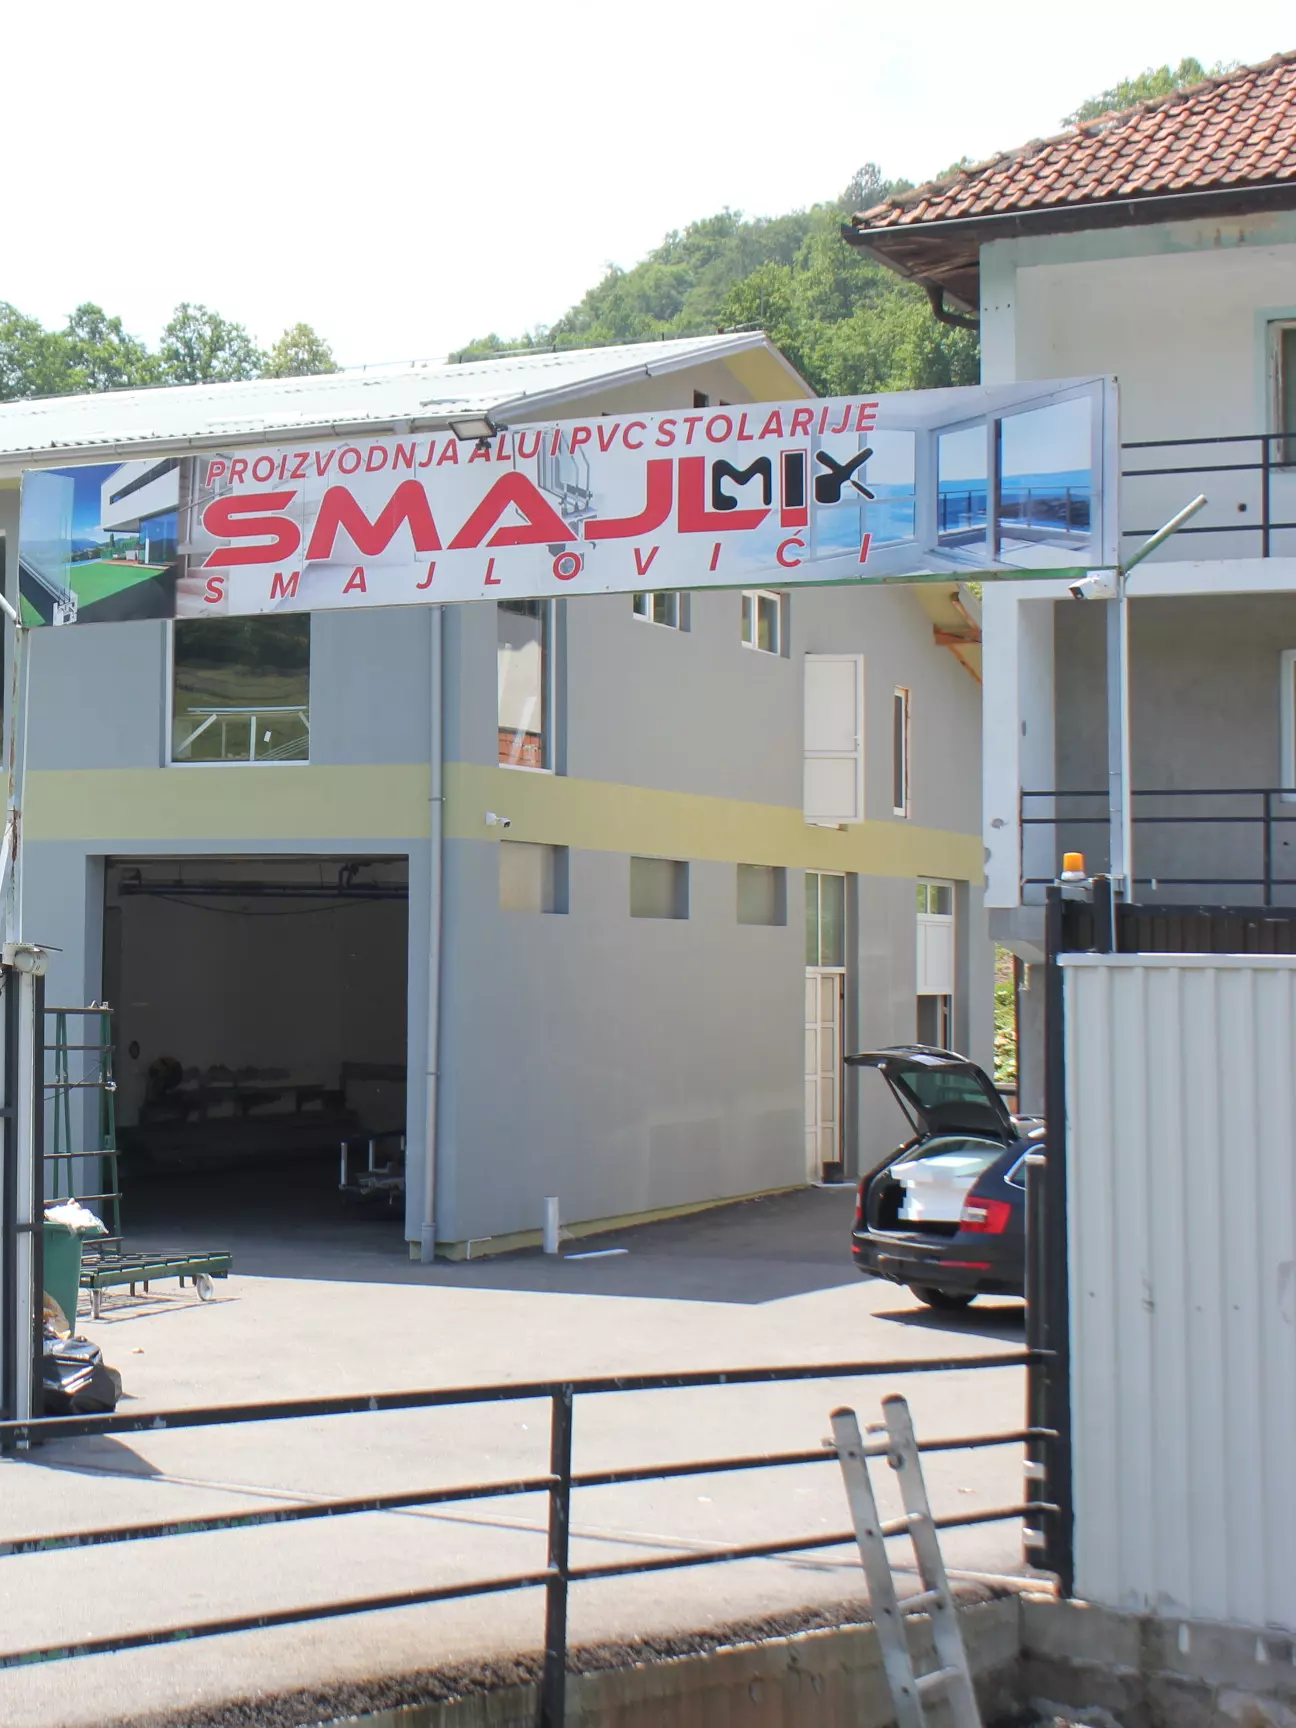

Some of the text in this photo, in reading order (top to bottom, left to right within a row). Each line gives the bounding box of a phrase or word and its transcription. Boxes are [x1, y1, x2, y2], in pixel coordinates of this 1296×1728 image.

[206, 438, 459, 487] PROIZVODNJA
[569, 421, 647, 455] PVC
[655, 402, 880, 447] STOLARIJE
